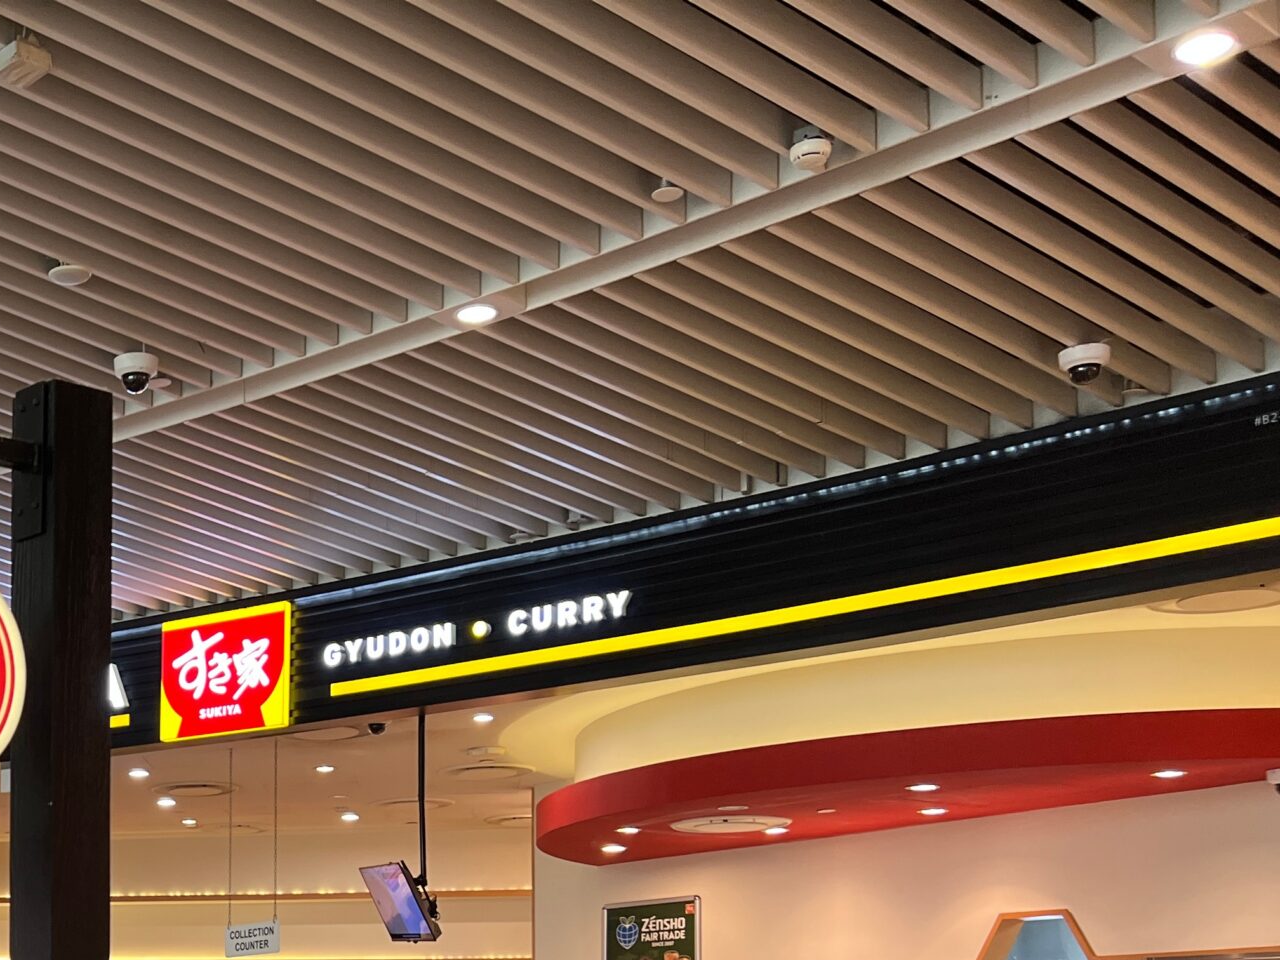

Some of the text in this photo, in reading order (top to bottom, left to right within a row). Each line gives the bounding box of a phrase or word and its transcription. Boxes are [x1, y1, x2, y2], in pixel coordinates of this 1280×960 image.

[322, 589, 634, 668] GYUDON CURRY
[171, 629, 270, 701] すき家
[198, 703, 242, 720] SUKIYA
[229, 926, 275, 940] COLLECTION
[641, 929, 686, 942] FAIR TRADE
[234, 939, 270, 952] COUNTER
